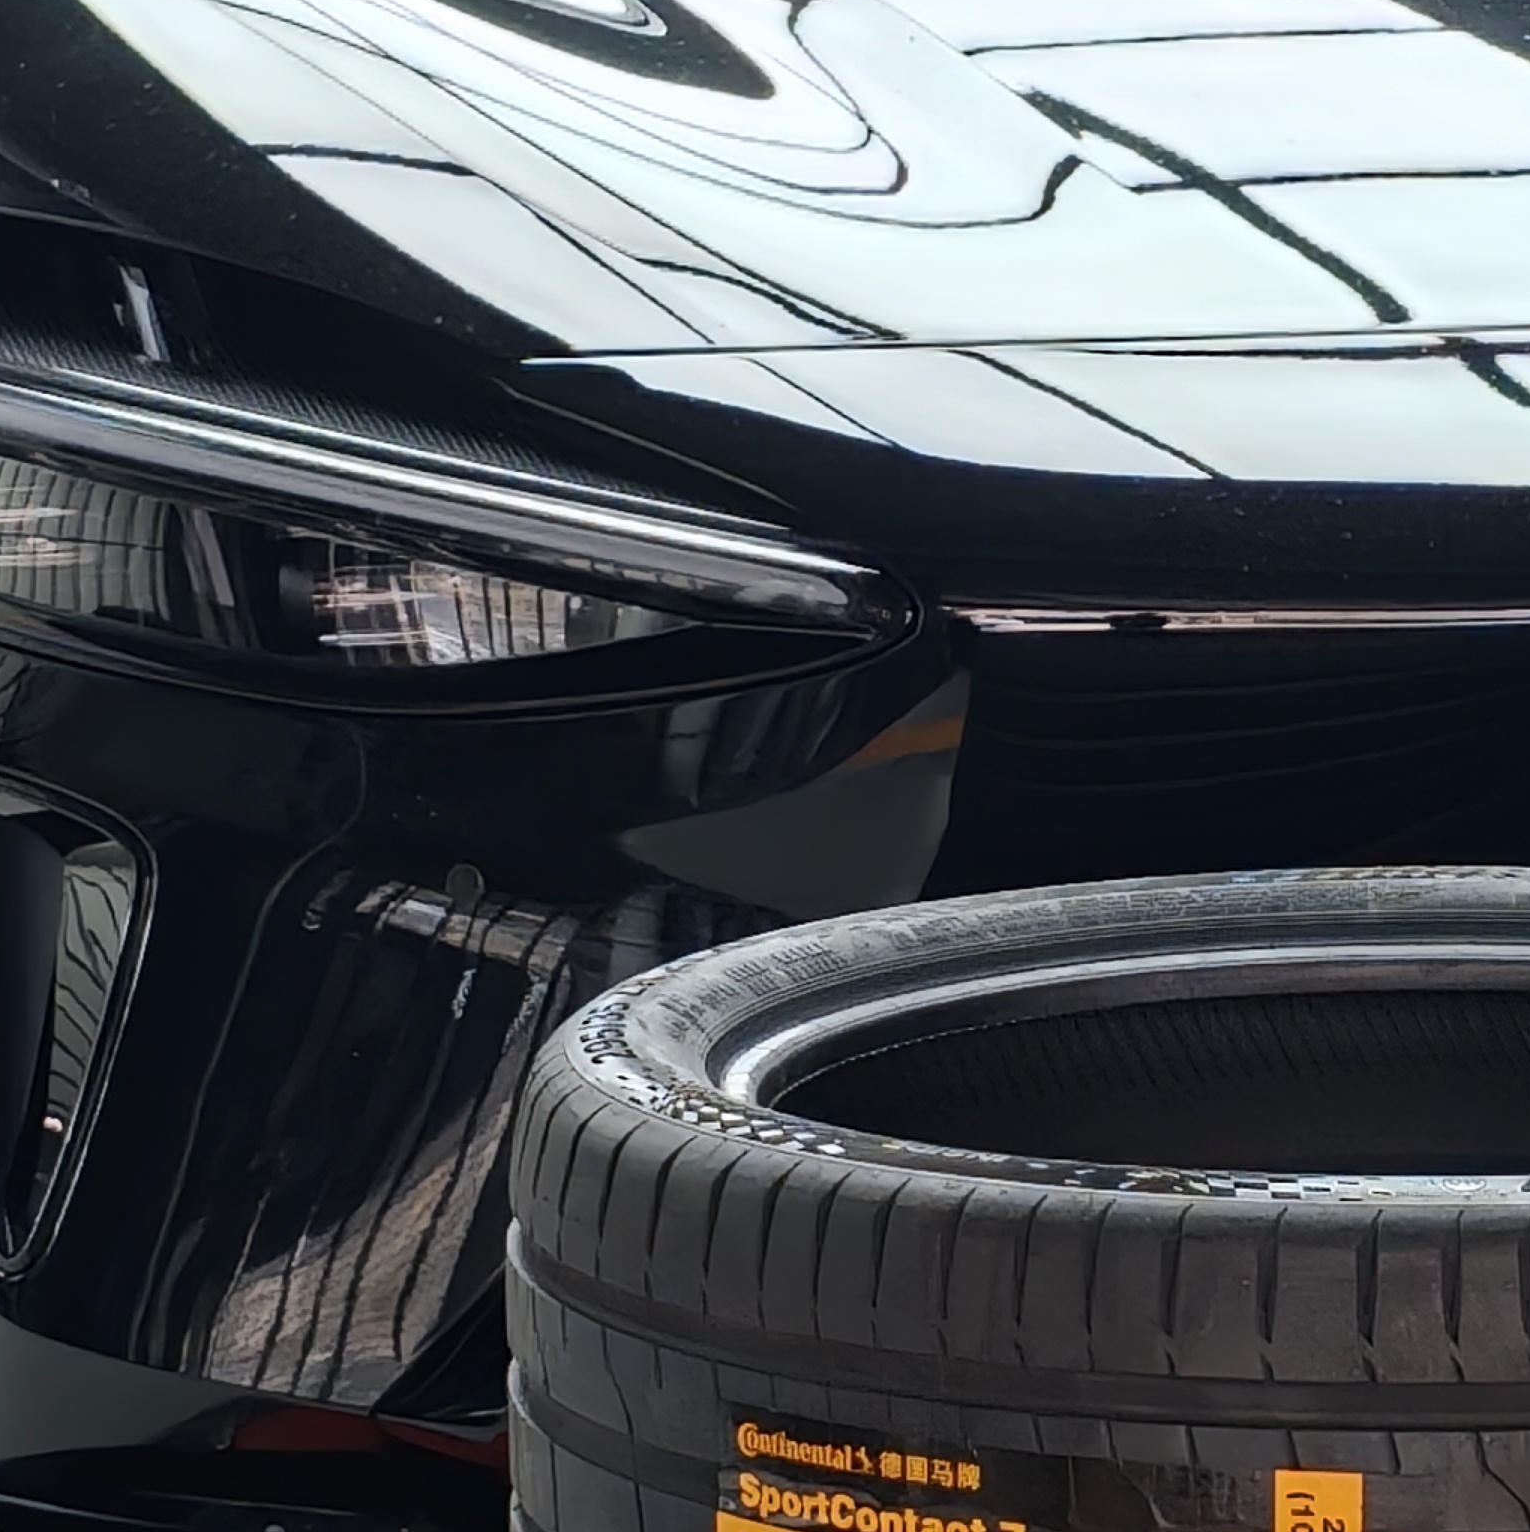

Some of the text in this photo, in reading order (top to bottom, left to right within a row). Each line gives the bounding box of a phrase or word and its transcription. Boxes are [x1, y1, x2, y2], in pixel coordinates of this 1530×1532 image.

[737, 1422, 982, 1490] Continental 德国马牌
